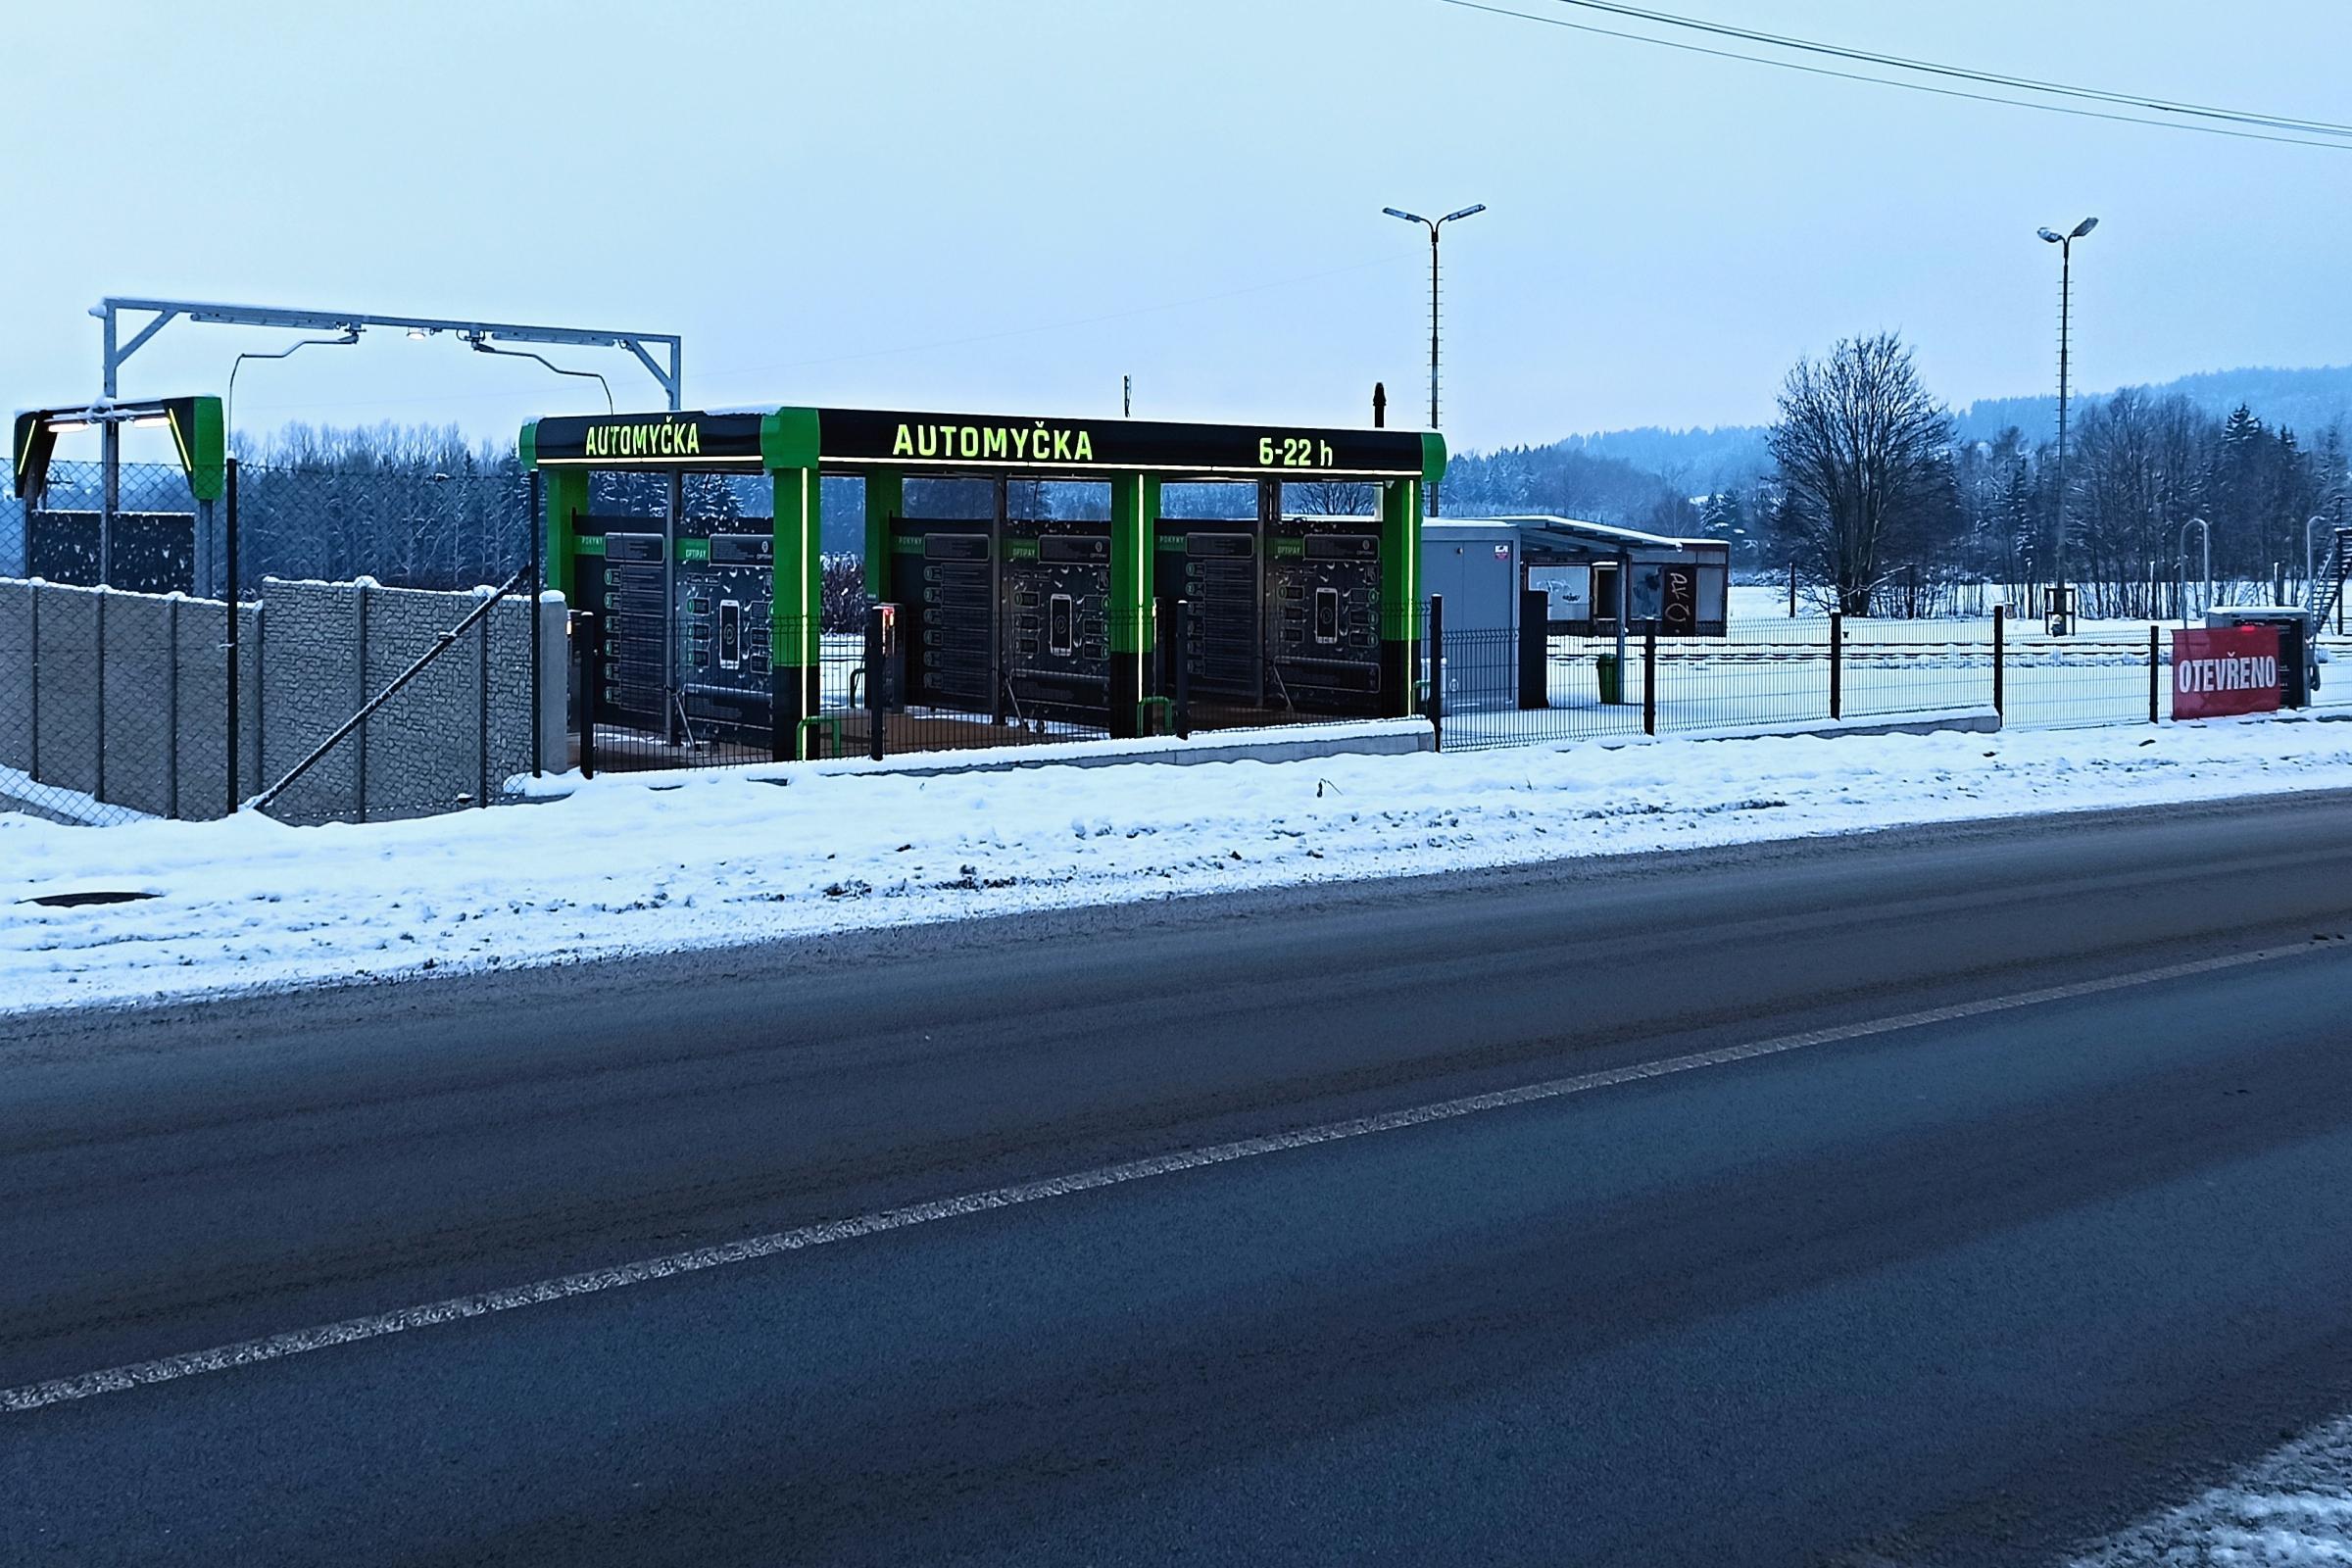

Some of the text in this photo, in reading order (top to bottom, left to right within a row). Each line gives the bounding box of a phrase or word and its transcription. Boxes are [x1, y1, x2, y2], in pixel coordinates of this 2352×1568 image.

[585, 416, 700, 456] AUTOMYČKA
[892, 420, 1094, 462] AUTOMYČKA
[1259, 437, 1333, 466] 6-22 h
[2179, 651, 2277, 693] OTEVŘENO
